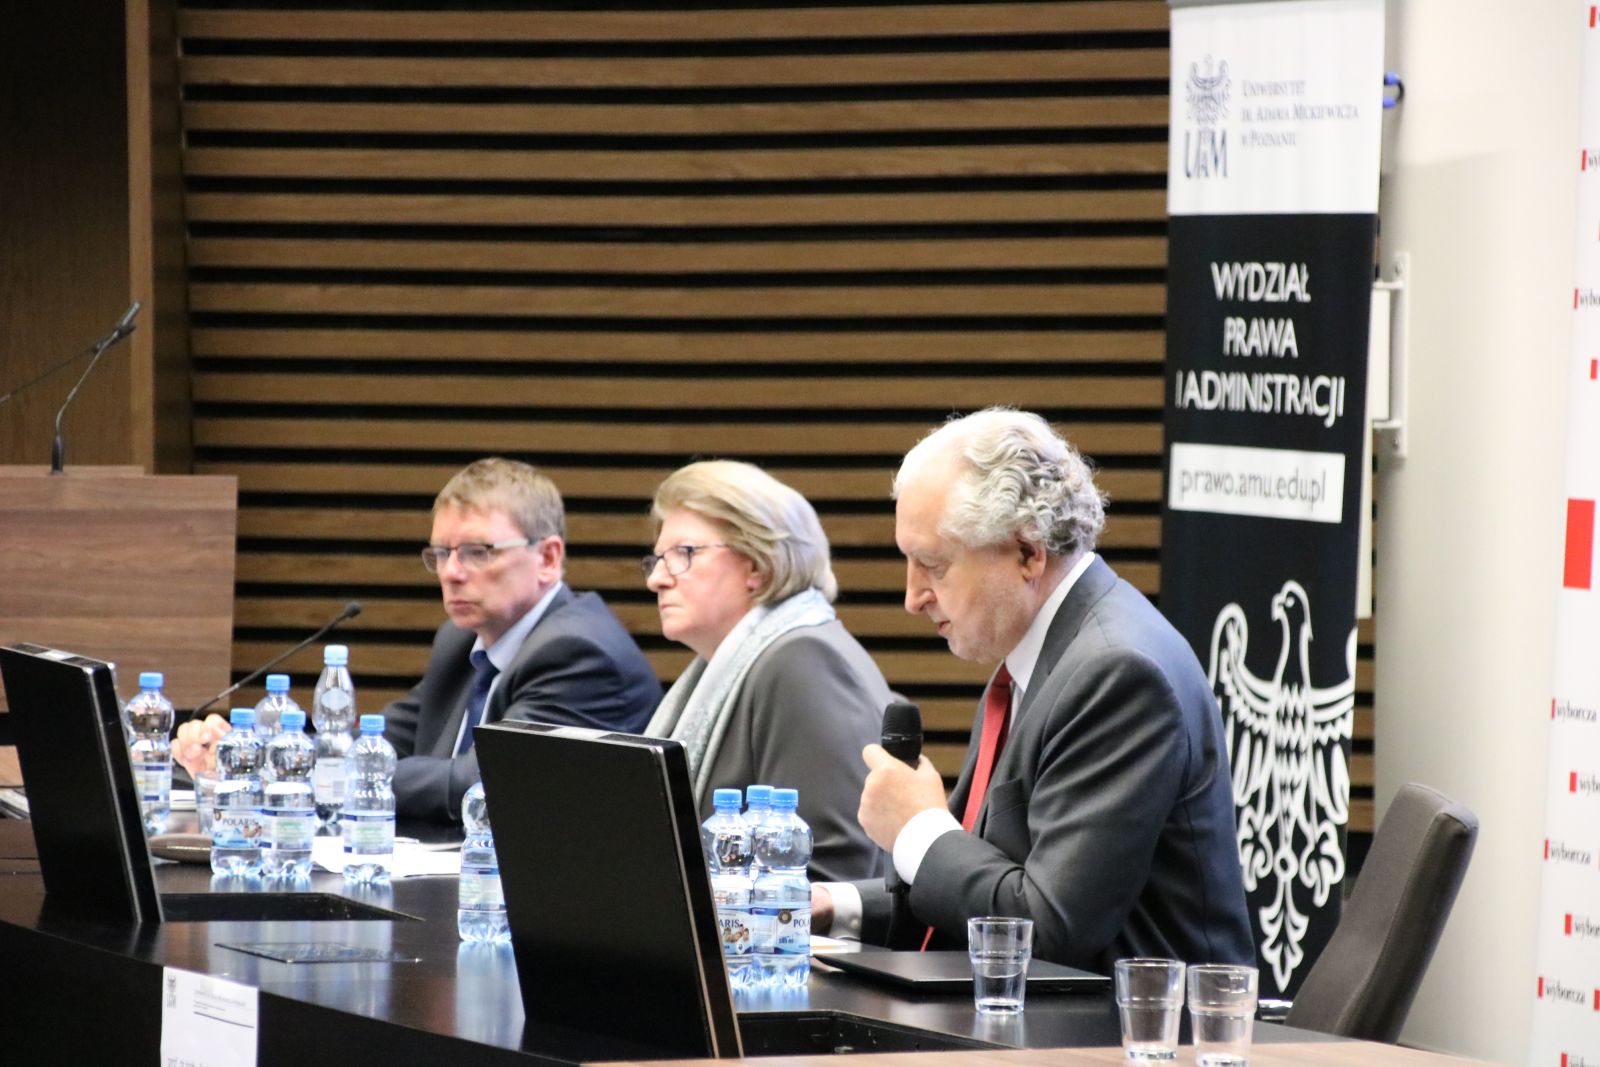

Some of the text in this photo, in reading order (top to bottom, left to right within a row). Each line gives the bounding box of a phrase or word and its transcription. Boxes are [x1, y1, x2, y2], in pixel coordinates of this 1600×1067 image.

[1210, 261, 1312, 303] WYDZIAŁ
[1222, 316, 1299, 359] PRAWA
[1175, 370, 1346, 429] I ADMINISTRACJI
[1180, 466, 1327, 513] prawo.amu.edu.pl
[1557, 699, 1598, 723] wyborcza
[1551, 841, 1591, 865] wyborcza
[1545, 980, 1586, 1005] wyborcza
